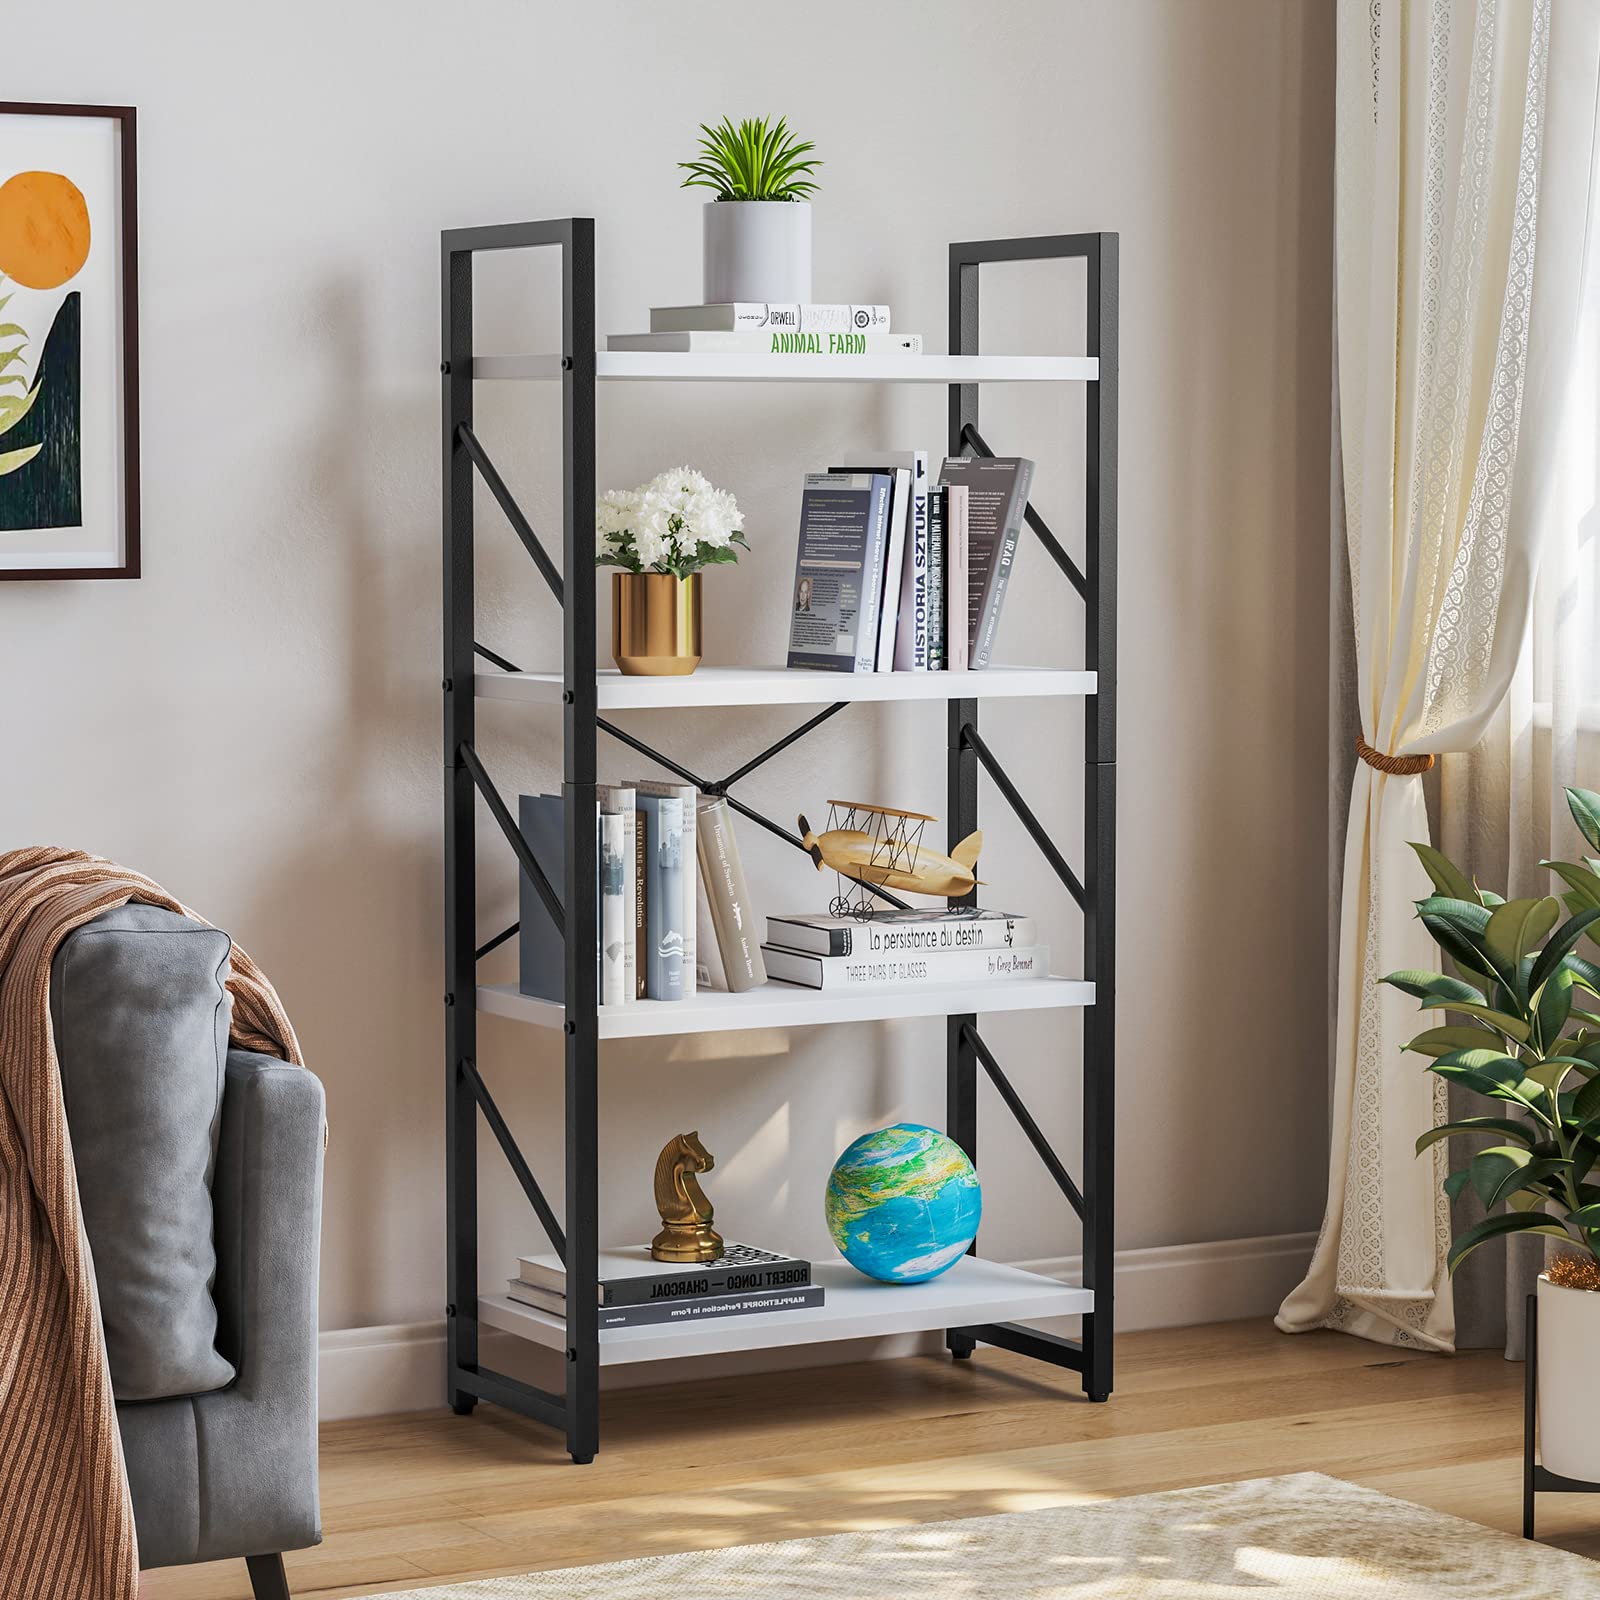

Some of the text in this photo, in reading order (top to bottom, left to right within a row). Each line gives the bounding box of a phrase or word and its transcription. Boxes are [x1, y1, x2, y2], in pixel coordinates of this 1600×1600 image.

[770, 311, 796, 326] ORWELL
[770, 332, 867, 354] ANIMAL FARM
[878, 487, 886, 514] Effective
[914, 460, 926, 667] HISTORIA SZTUKI 1
[1002, 539, 1015, 566] IRAQ
[714, 824, 736, 897] Dreaming of Sweden
[869, 927, 880, 950] La
[882, 926, 938, 955] persistance
[940, 924, 952, 946] du
[956, 922, 984, 946] destin
[846, 962, 928, 982] THREE PAIRS OF GLASSES
[988, 956, 996, 975] by
[996, 956, 1012, 974] Greg
